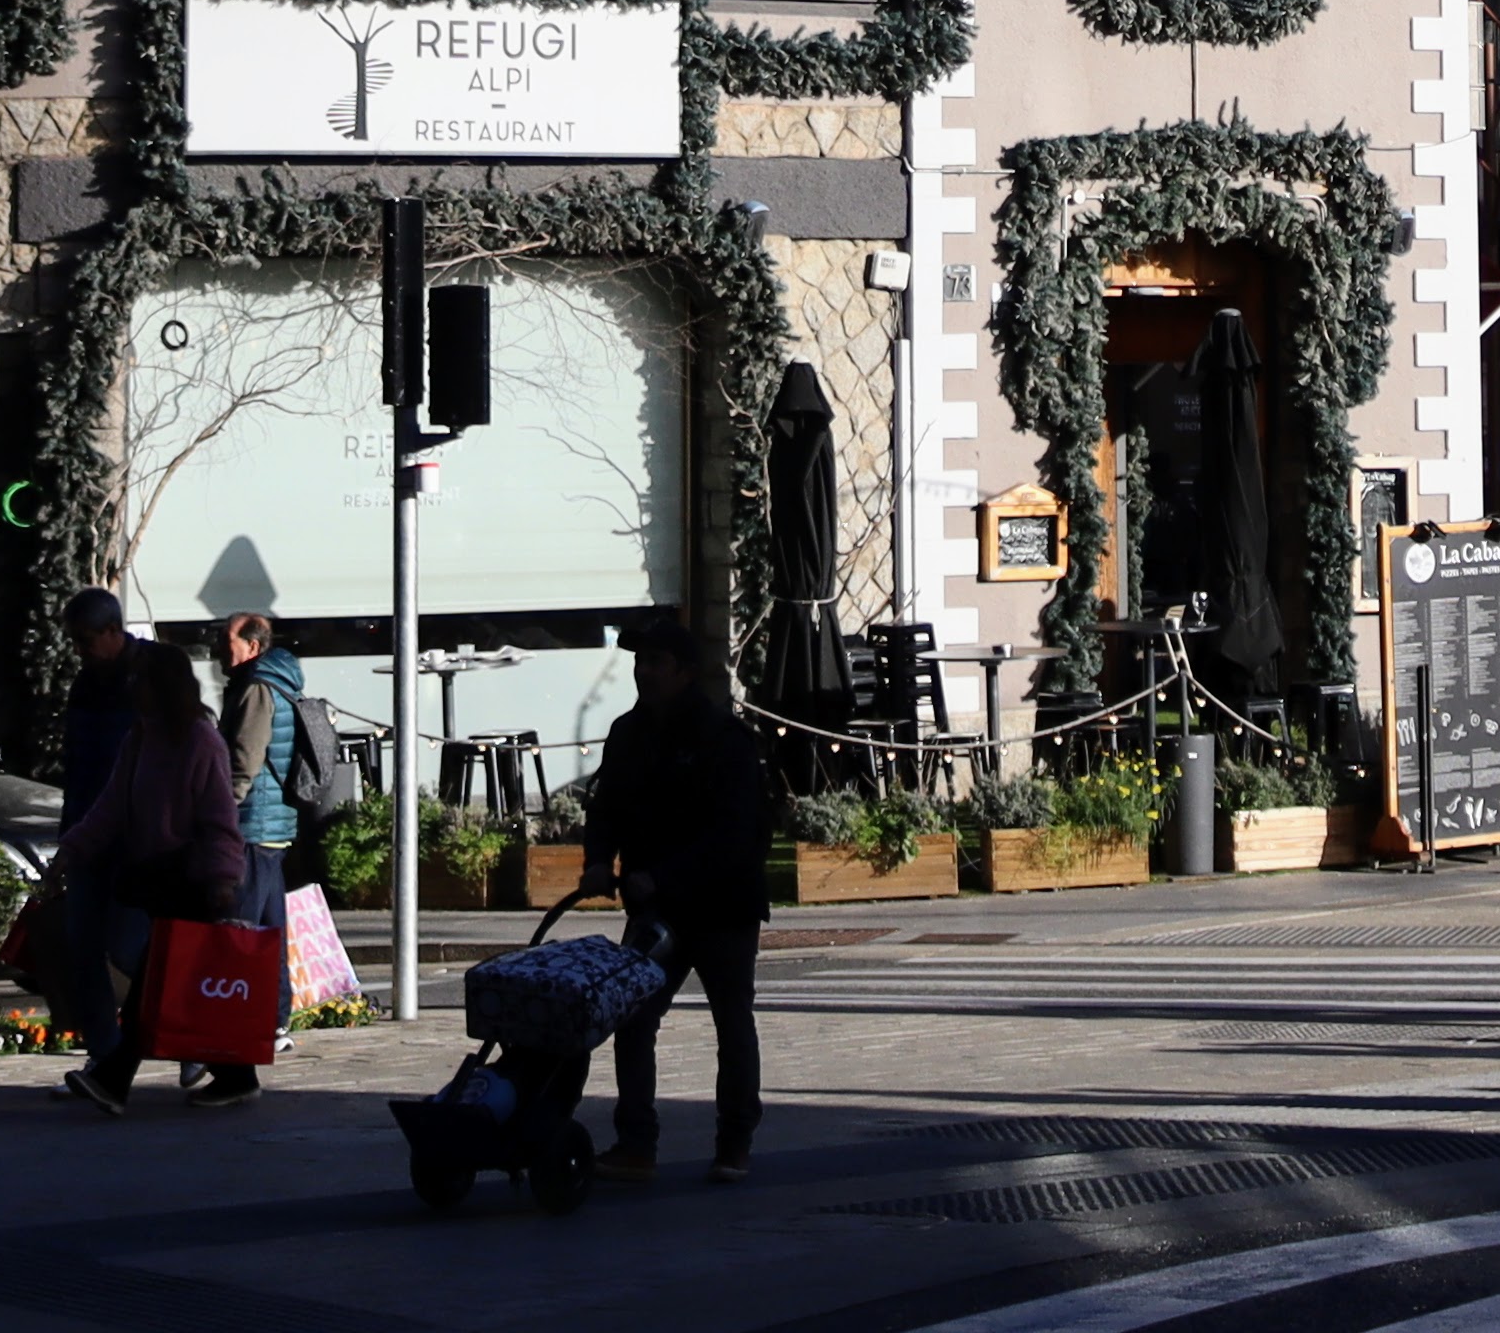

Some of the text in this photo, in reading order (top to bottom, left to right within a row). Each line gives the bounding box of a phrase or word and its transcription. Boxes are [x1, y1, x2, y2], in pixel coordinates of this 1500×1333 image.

[417, 19, 576, 60] REFUGI
[468, 66, 530, 92] ALPI
[415, 120, 575, 142] RESTAURANT
[946, 274, 971, 299] 73
[1440, 544, 1461, 565] La
